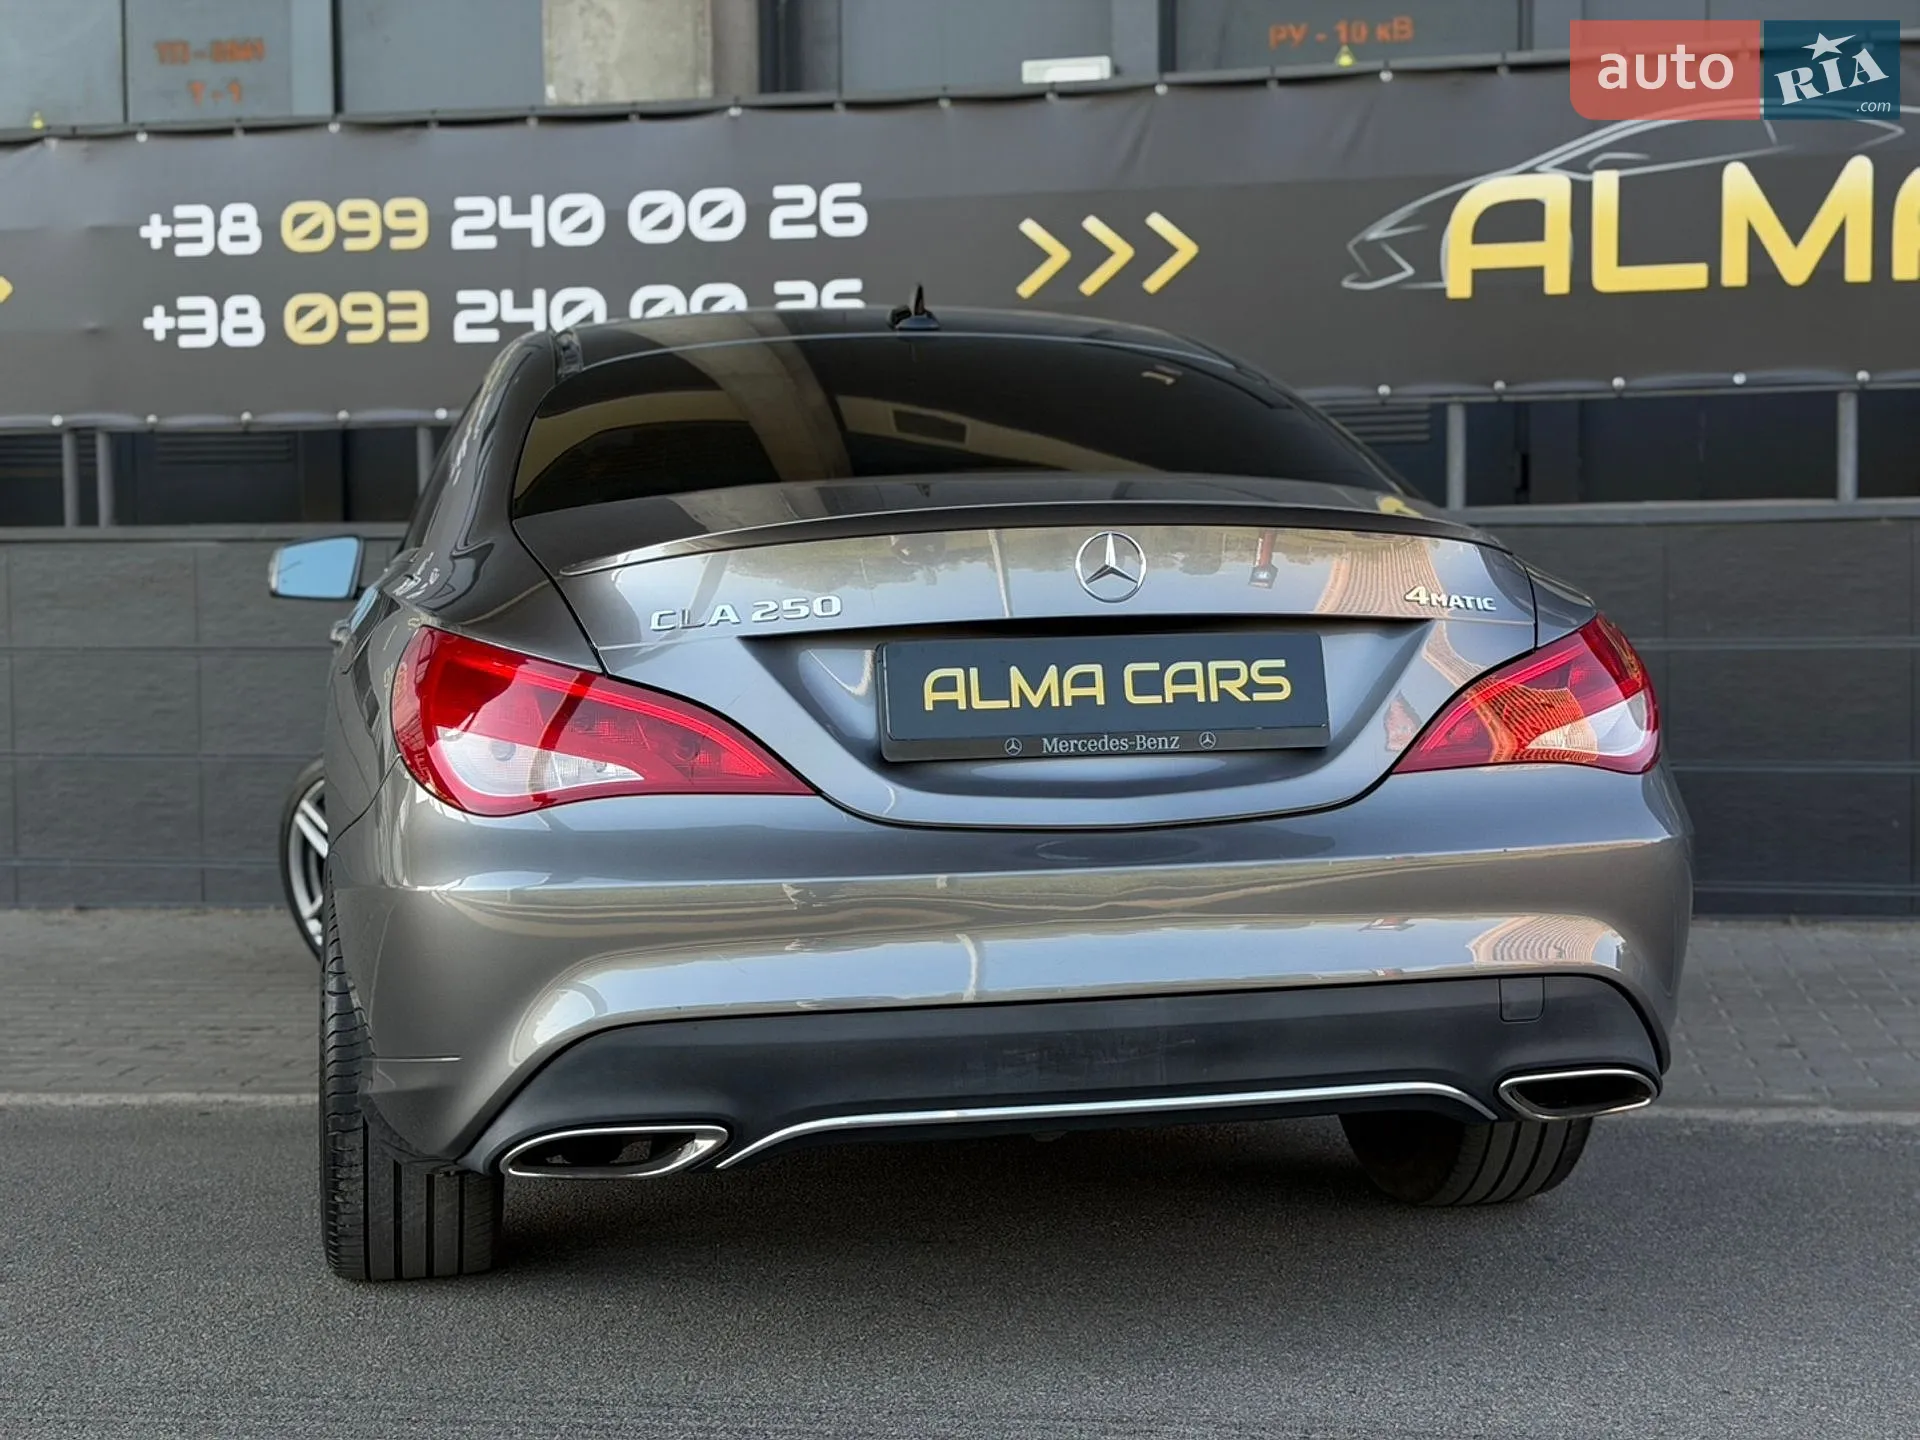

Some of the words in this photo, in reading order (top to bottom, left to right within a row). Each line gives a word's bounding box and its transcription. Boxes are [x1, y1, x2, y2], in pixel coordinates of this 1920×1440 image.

[140, 202, 262, 257] +38
[281, 196, 429, 253] 099
[451, 192, 606, 250] 240
[627, 187, 747, 244] 00
[769, 182, 868, 240] 26
[1445, 155, 1920, 299] ALM
[142, 294, 266, 349] +38
[283, 290, 430, 345] 093
[453, 286, 608, 344] 240
[650, 604, 741, 631] CLA
[751, 595, 843, 623] 250
[1405, 585, 1497, 612] 4MATIC
[923, 664, 1105, 711] ALMA
[1123, 659, 1292, 705] CARS
[1042, 734, 1180, 754] Mercedes-Benz
